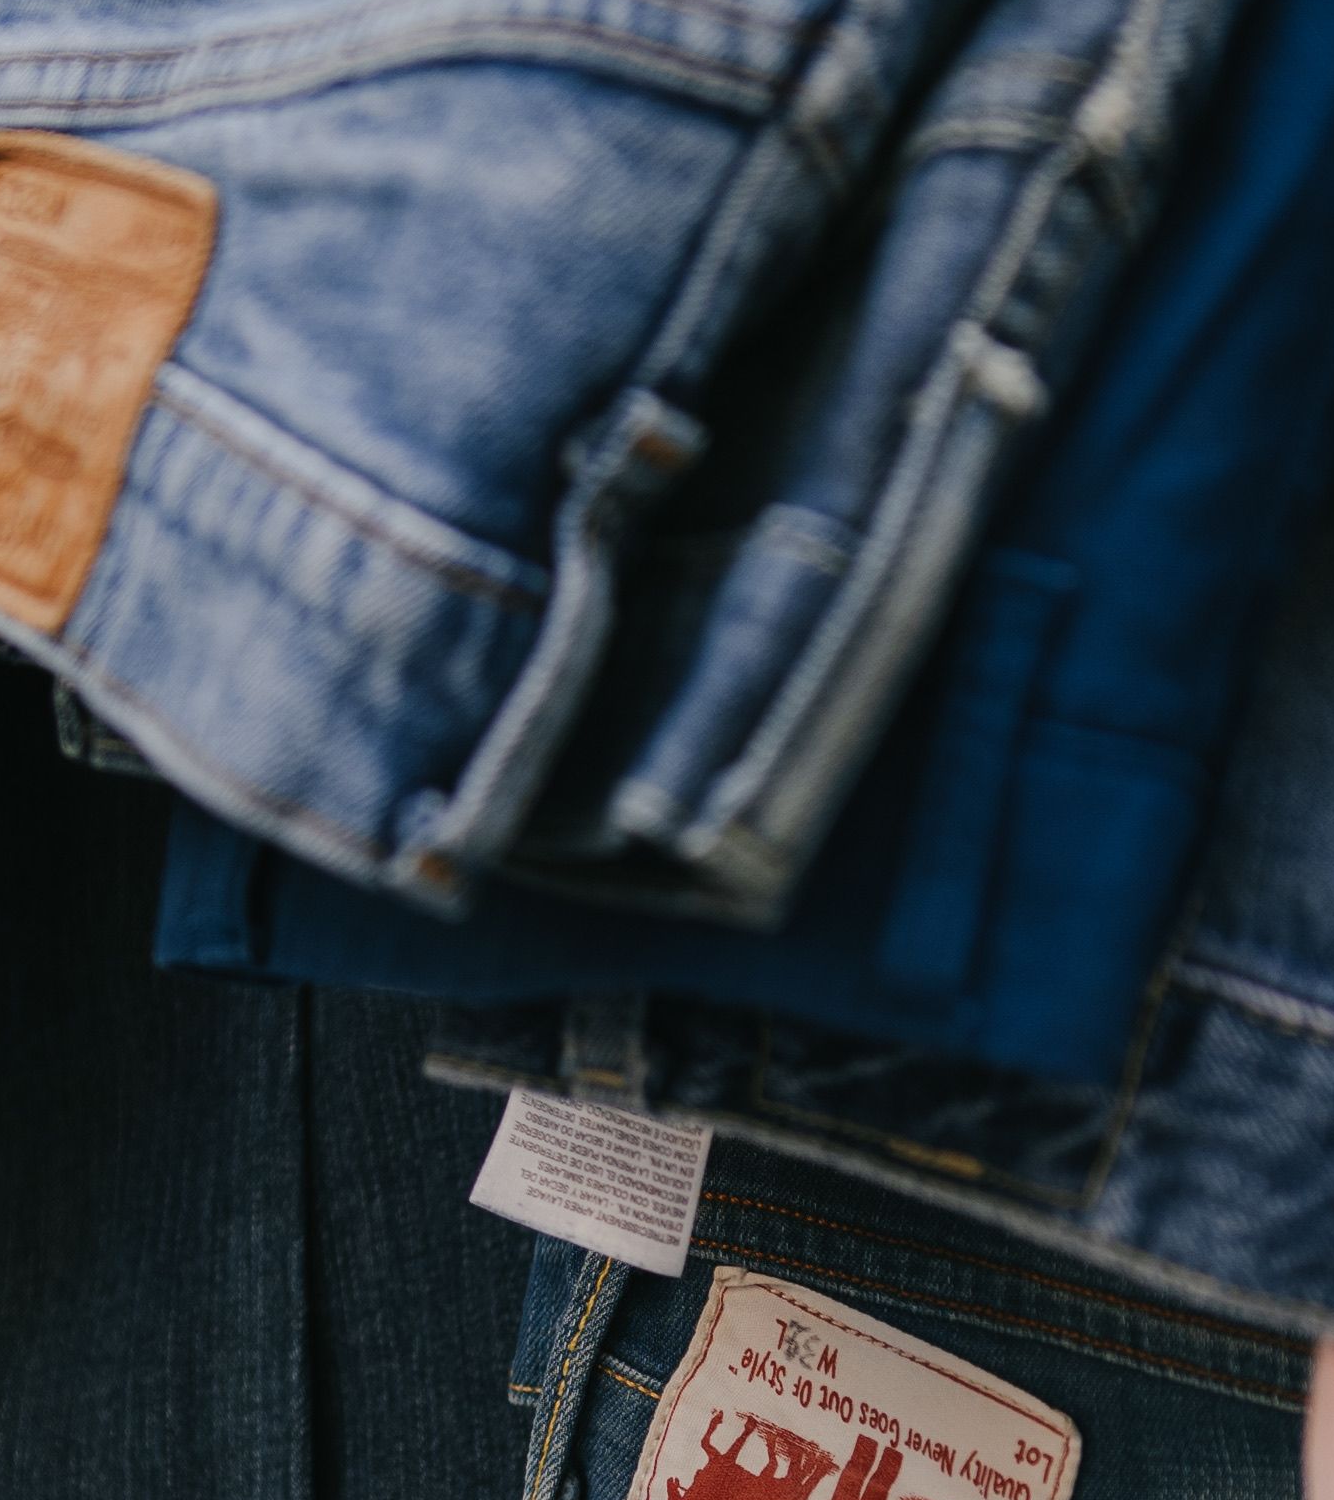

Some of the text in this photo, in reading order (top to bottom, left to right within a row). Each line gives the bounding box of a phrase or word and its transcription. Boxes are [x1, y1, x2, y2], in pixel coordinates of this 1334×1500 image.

[512, 1119, 568, 1150] ENCOGERSE
[559, 1124, 573, 1137] DO
[573, 1129, 605, 1147] SECAR
[507, 1132, 569, 1165] DETERGENTE
[567, 1141, 600, 1161] PUEDE
[568, 1156, 583, 1170] DE
[582, 1161, 604, 1178] USO
[599, 1153, 638, 1174] PRENDA
[537, 1175, 569, 1194] SECAR
[585, 1176, 629, 1201] COLORES
[628, 1192, 650, 1208] CON
[763, 1317, 791, 1351] L
[812, 1341, 847, 1378] W
[813, 1384, 858, 1425] Out
[851, 1402, 907, 1448] Goes
[898, 1425, 959, 1475] Never
[1006, 1437, 1058, 1483] Lot
